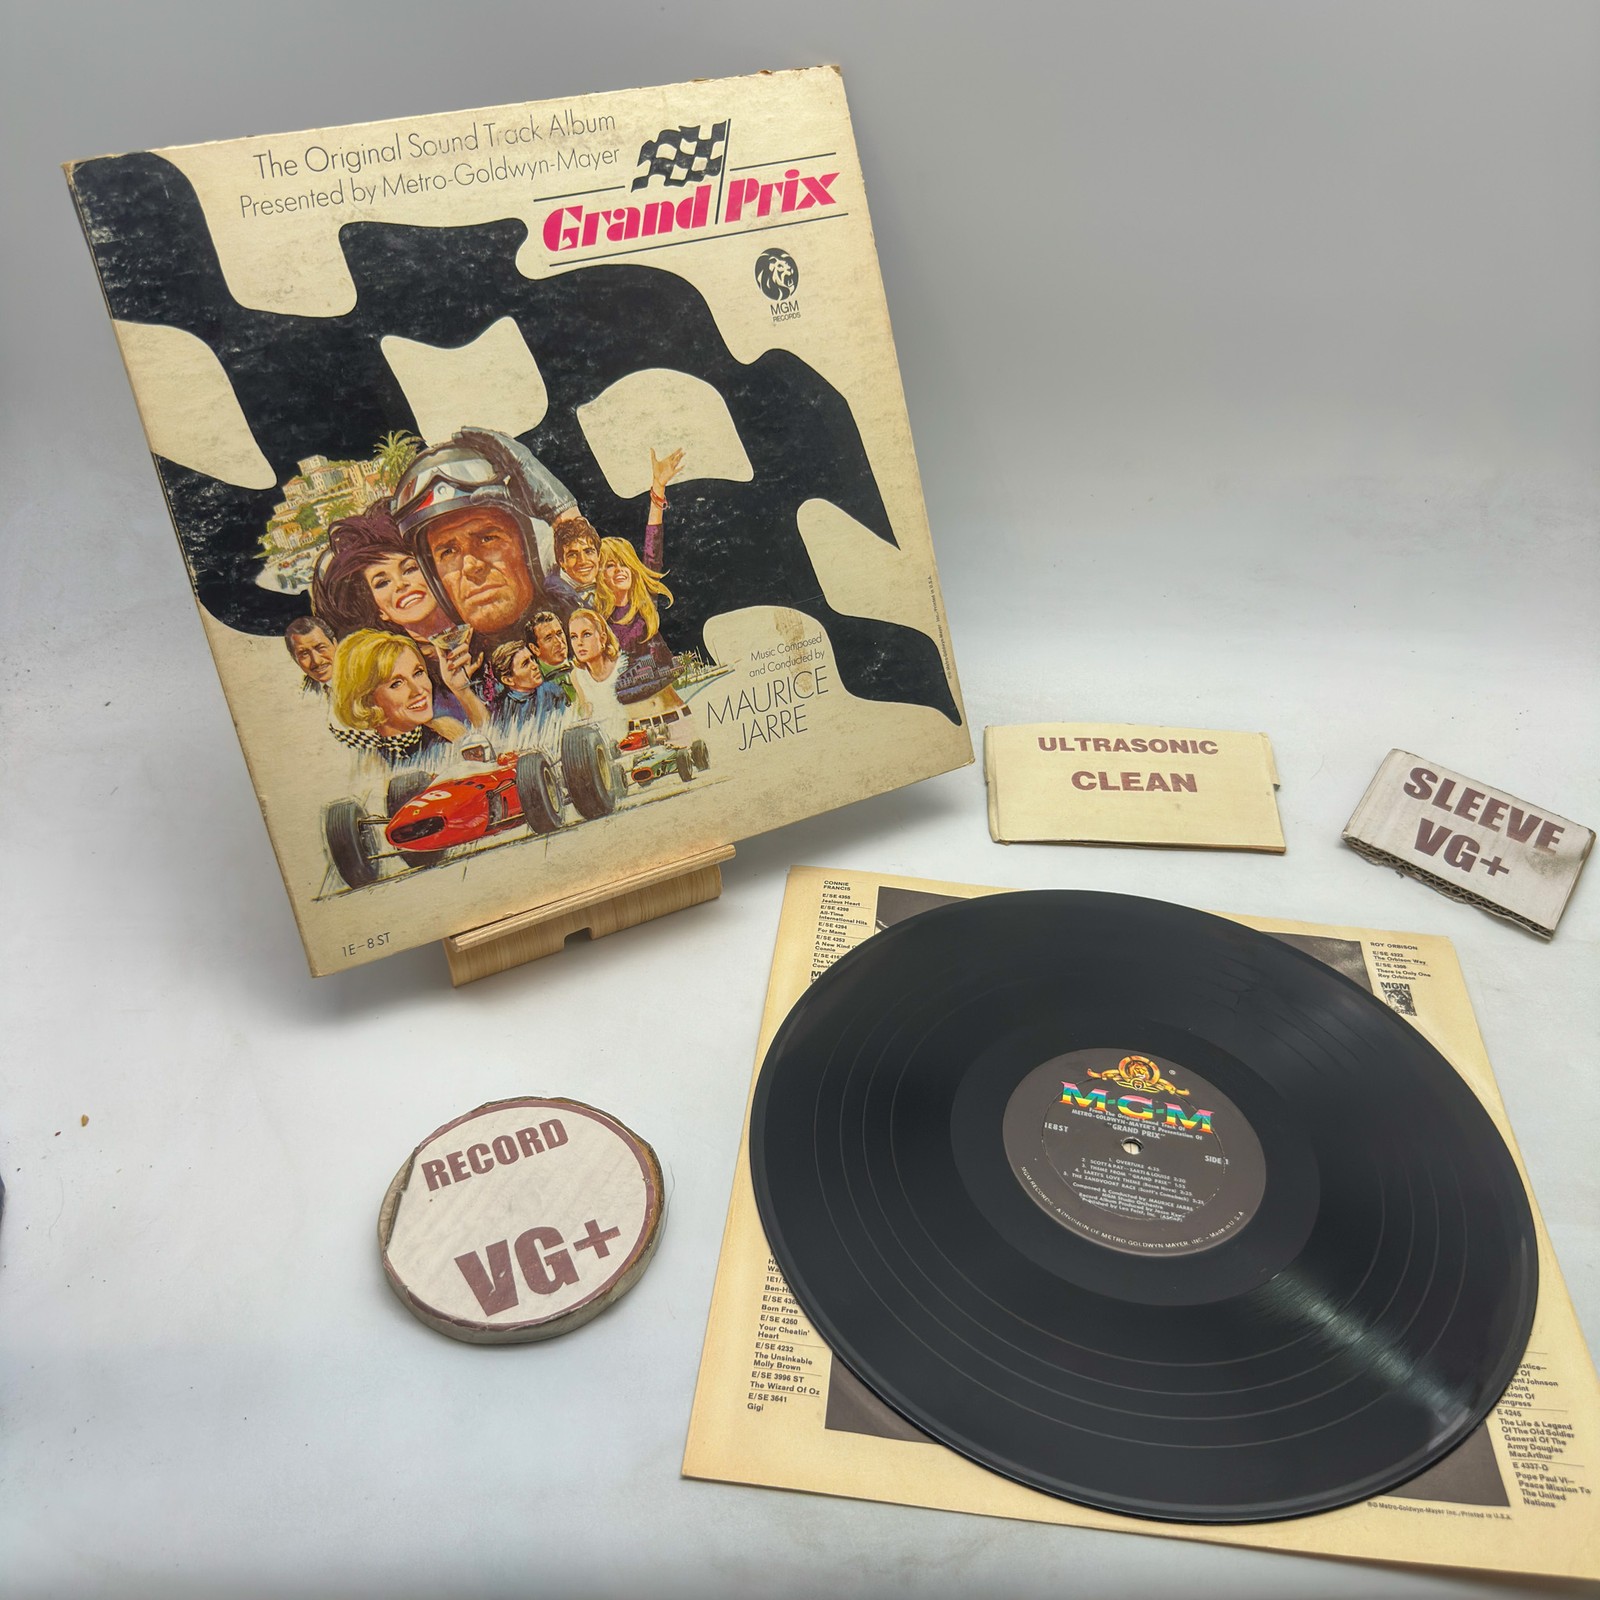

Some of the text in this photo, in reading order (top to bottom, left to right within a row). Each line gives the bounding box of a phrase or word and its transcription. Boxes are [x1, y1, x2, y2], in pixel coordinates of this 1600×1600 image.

[253, 150, 298, 179] The
[304, 133, 402, 174] Original
[408, 122, 479, 158] Sound
[549, 108, 616, 137] Album
[240, 148, 620, 218] Presented by Metro-Goldwyn-Mayer
[542, 169, 840, 252] Grand Prix
[770, 300, 800, 316] MGM
[772, 312, 802, 322] RECORDS
[750, 631, 823, 661] Music Composed
[749, 649, 827, 678] and Conducted by
[707, 665, 829, 729] MAURICE
[738, 704, 808, 751] JARRE
[1038, 736, 1219, 756] ULTRASONIC
[1071, 770, 1198, 793] CLEAN
[1402, 765, 1566, 854] SLEEVE
[1413, 817, 1511, 879] VG+
[819, 915, 855, 923] International
[1386, 943, 1418, 951] ORBISON
[1380, 981, 1410, 990] MGM
[1117, 1112, 1140, 1121] Original
[1142, 1118, 1159, 1126] Sound
[1158, 1127, 1193, 1138] Presentation
[421, 1118, 569, 1192] RECORD
[1204, 1155, 1222, 1165] SIDE
[453, 1219, 621, 1317] VG+
[762, 1295, 782, 1303] E/SE
[761, 1304, 798, 1314] Born Free
[760, 1314, 798, 1325] E/SE 4260
[758, 1331, 779, 1340] Heart
[759, 1323, 810, 1336] Your Cheatin'
[755, 1342, 794, 1352] E/SE 4232
[770, 1353, 813, 1365] Unsinkable
[753, 1360, 801, 1371] Molly Brown
[751, 1371, 804, 1383] E/SE 3996 ST
[1526, 1378, 1559, 1387] Johnson
[750, 1381, 765, 1389] The
[767, 1382, 794, 1392] Wizard
[809, 1387, 820, 1395] Oz
[748, 1393, 769, 1401] E/SE
[747, 1403, 764, 1412] Gigi
[1499, 1418, 1514, 1426] The
[1542, 1422, 1573, 1430] Legend
[1546, 1429, 1575, 1438] Soldier
[1507, 1443, 1564, 1453] Army Douglas
[1551, 1438, 1567, 1446] The
[1509, 1451, 1553, 1460] MacArthur
[1515, 1472, 1538, 1480] Pope
[1539, 1474, 1557, 1483] Paul
[1518, 1480, 1591, 1494] Peace Mission To
[1520, 1488, 1566, 1500] The United
[1523, 1498, 1556, 1508] Nations
